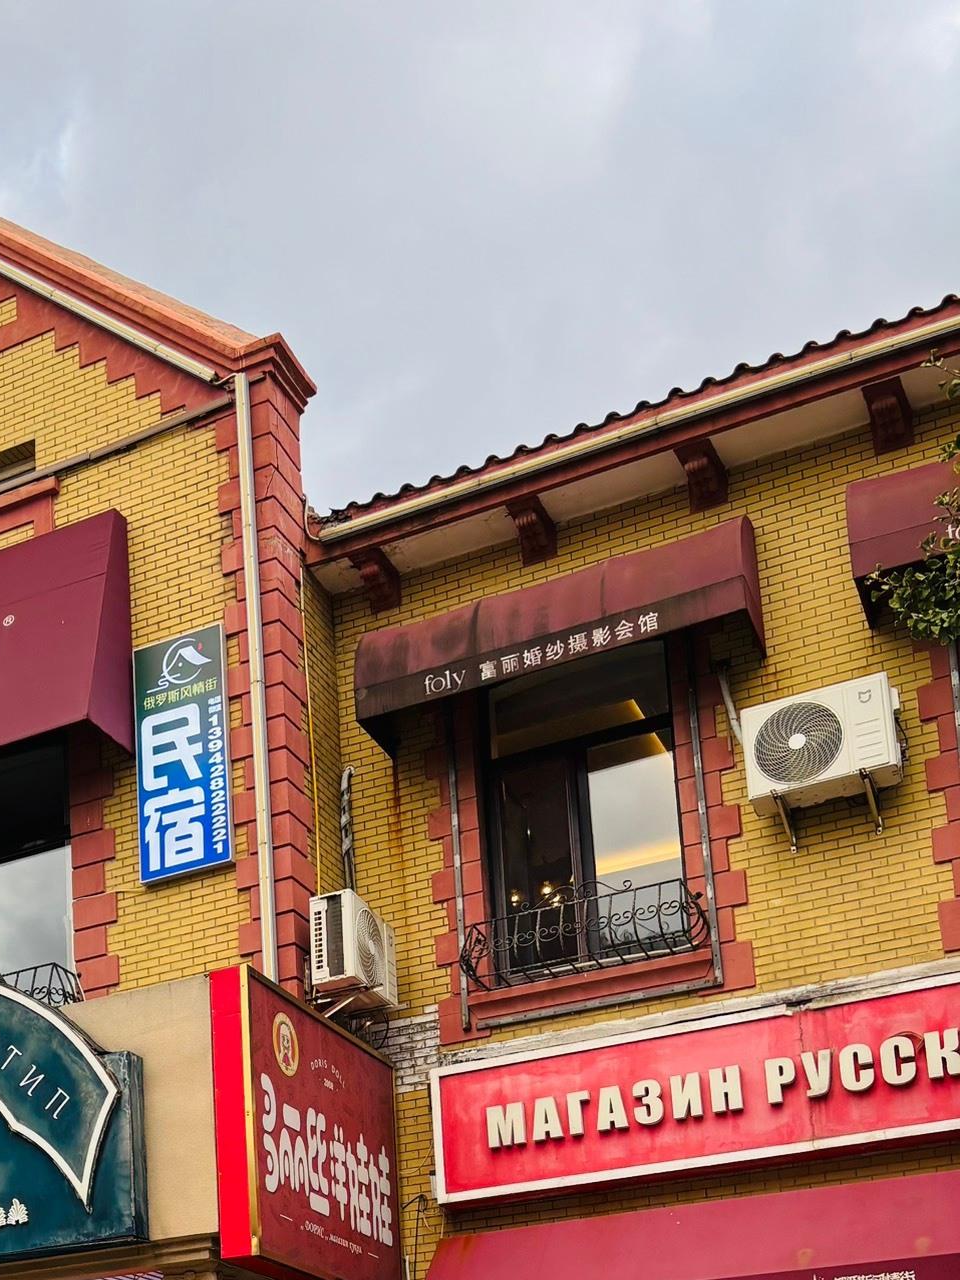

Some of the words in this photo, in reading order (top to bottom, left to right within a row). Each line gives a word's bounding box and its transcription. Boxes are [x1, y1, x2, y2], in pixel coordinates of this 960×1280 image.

[143, 677, 218, 711] 俄罗斯风情街
[423, 666, 466, 696] foly
[479, 611, 660, 682] 富丽婚纱摄影会馆
[140, 702, 206, 872] 民宿
[207, 716, 227, 854] 13942822221
[485, 1064, 745, 1150] МАГАЗИН
[764, 1027, 960, 1106] РУССК
